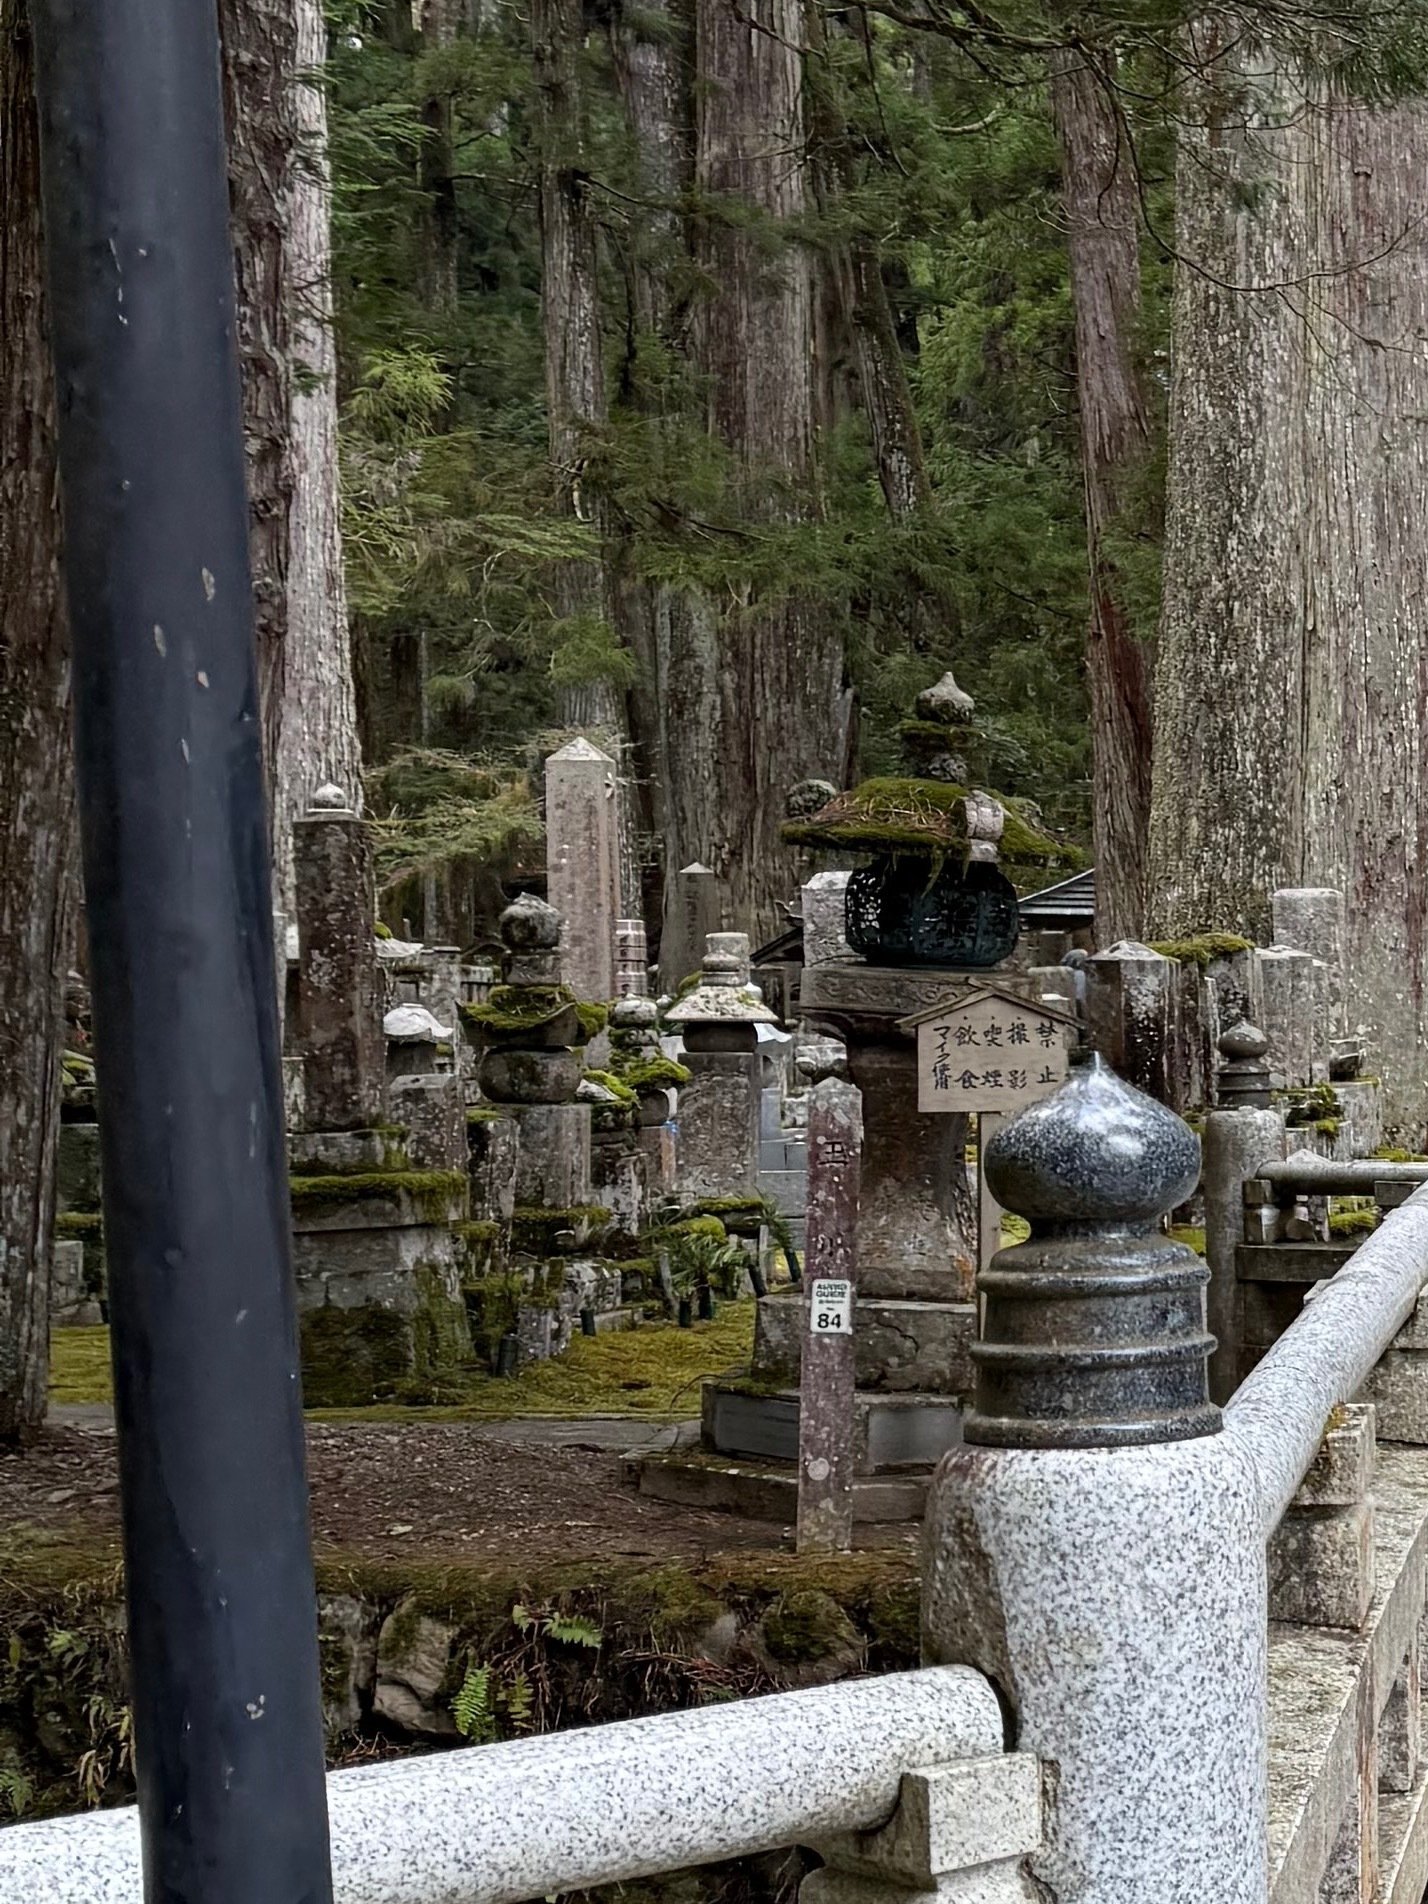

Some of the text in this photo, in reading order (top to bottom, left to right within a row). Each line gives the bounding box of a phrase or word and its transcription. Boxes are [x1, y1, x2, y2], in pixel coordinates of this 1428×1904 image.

[952, 1024, 982, 1089] 飲食
[981, 1023, 1004, 1089] 喫煙
[1006, 1022, 1031, 1090] 撮影
[1035, 1021, 1058, 1084] 禁止
[817, 1313, 842, 1329] 84
